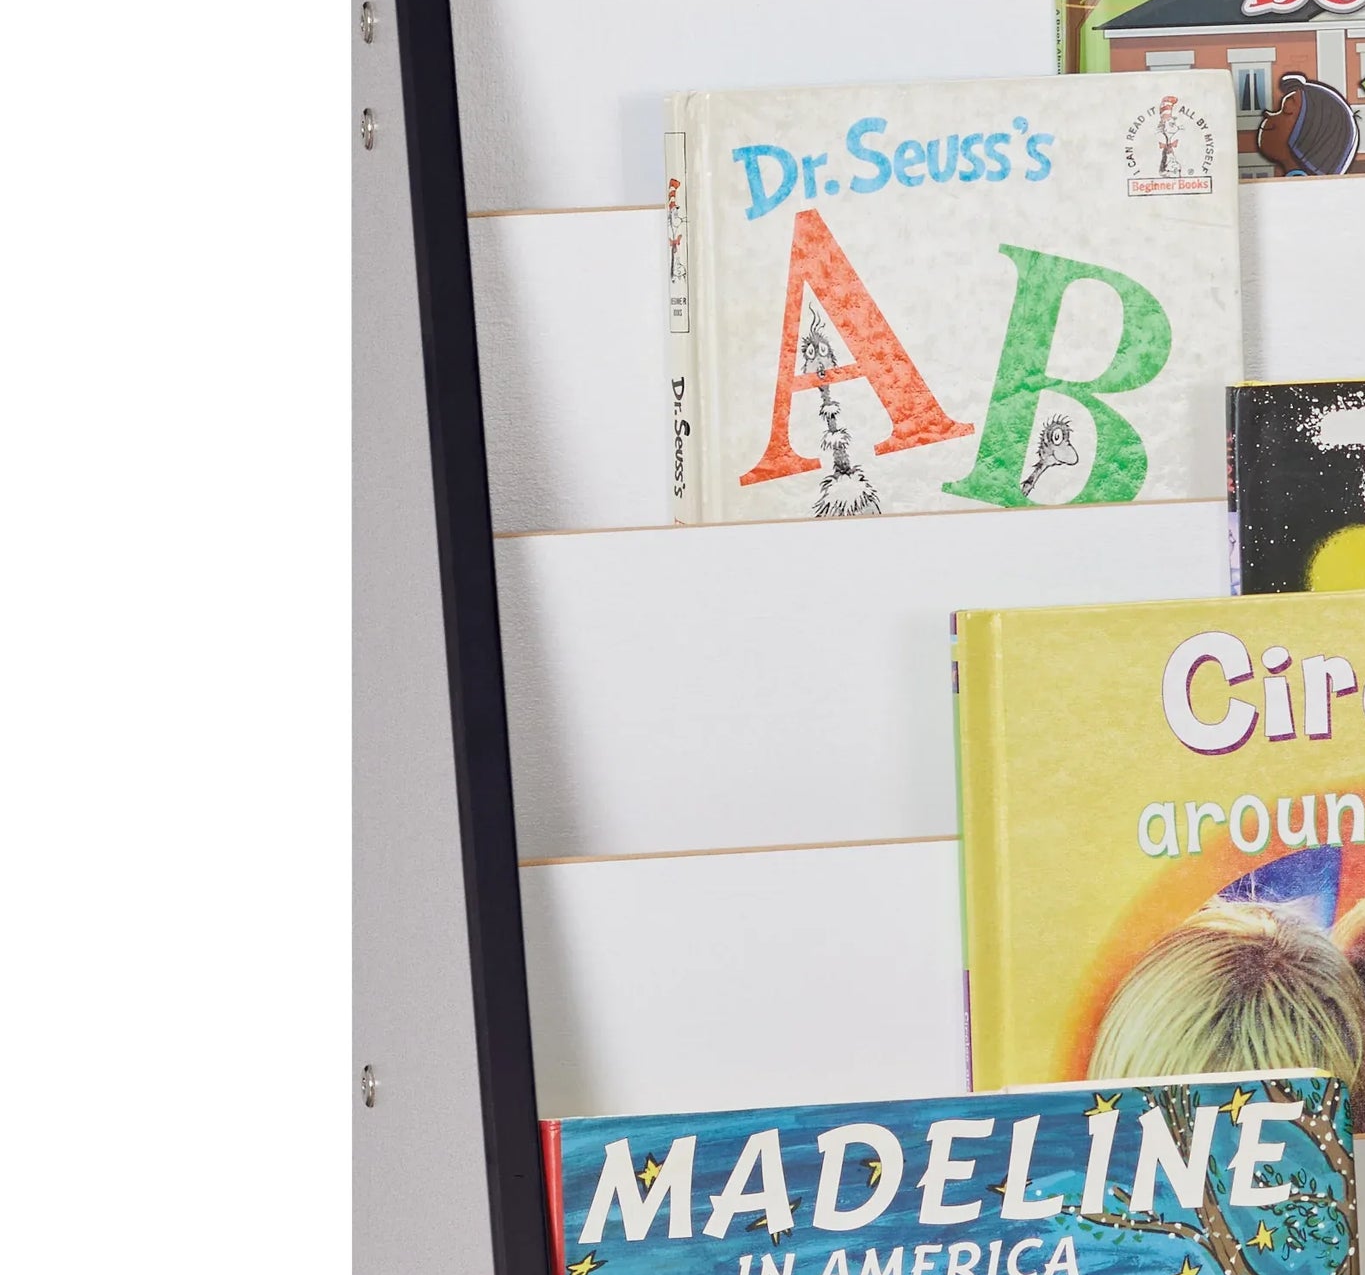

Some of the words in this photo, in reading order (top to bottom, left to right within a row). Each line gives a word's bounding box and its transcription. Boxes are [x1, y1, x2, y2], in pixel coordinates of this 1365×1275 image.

[1146, 106, 1156, 117] IT
[1178, 105, 1196, 120] ALL
[1196, 118, 1209, 131] BY
[1126, 115, 1146, 141] READ
[1125, 146, 1136, 168] CAN
[1201, 133, 1214, 174] MYSELF
[731, 142, 840, 221] Dr.
[847, 116, 1055, 194] Seuss's
[1132, 180, 1177, 193] Beginner
[1178, 178, 1209, 190] Books
[671, 376, 685, 416] Dr.
[673, 419, 690, 499] Seuss's
[577, 1099, 1306, 1245] MADELINE
